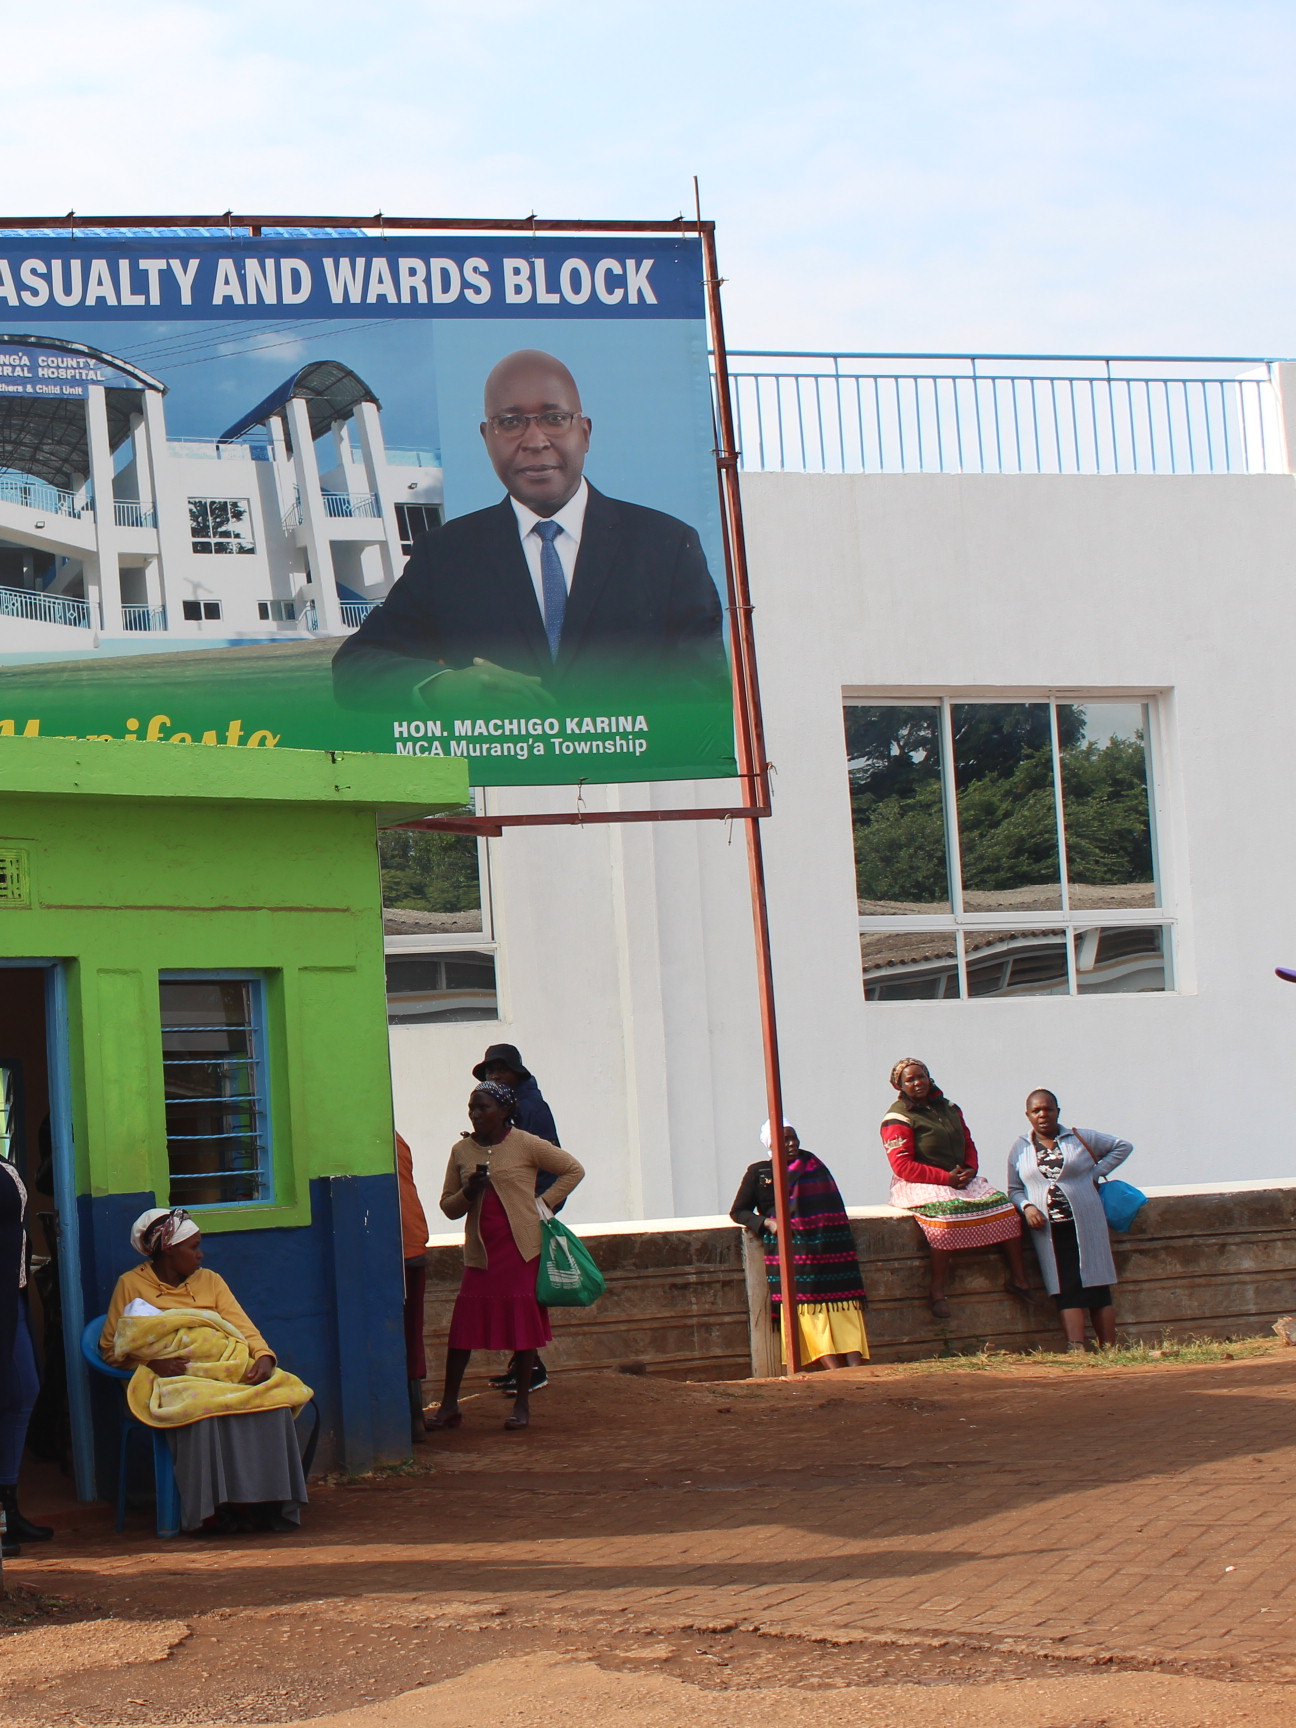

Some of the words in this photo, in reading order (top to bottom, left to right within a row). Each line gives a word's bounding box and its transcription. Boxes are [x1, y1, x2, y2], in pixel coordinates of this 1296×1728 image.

[212, 257, 312, 305] AND
[322, 257, 492, 305] WARDS
[502, 257, 658, 305] BLOCK
[38, 356, 97, 369] COUNTY
[38, 368, 106, 381] HOSPITAL
[26, 384, 33, 393] &
[36, 384, 60, 394] Child
[62, 386, 82, 395] Unit
[393, 720, 448, 738] HON.
[454, 718, 560, 737] MACHIGO
[566, 715, 648, 734] KARINA
[396, 741, 444, 757] MCA
[449, 738, 545, 760] Murang'a
[550, 735, 647, 756] Township
